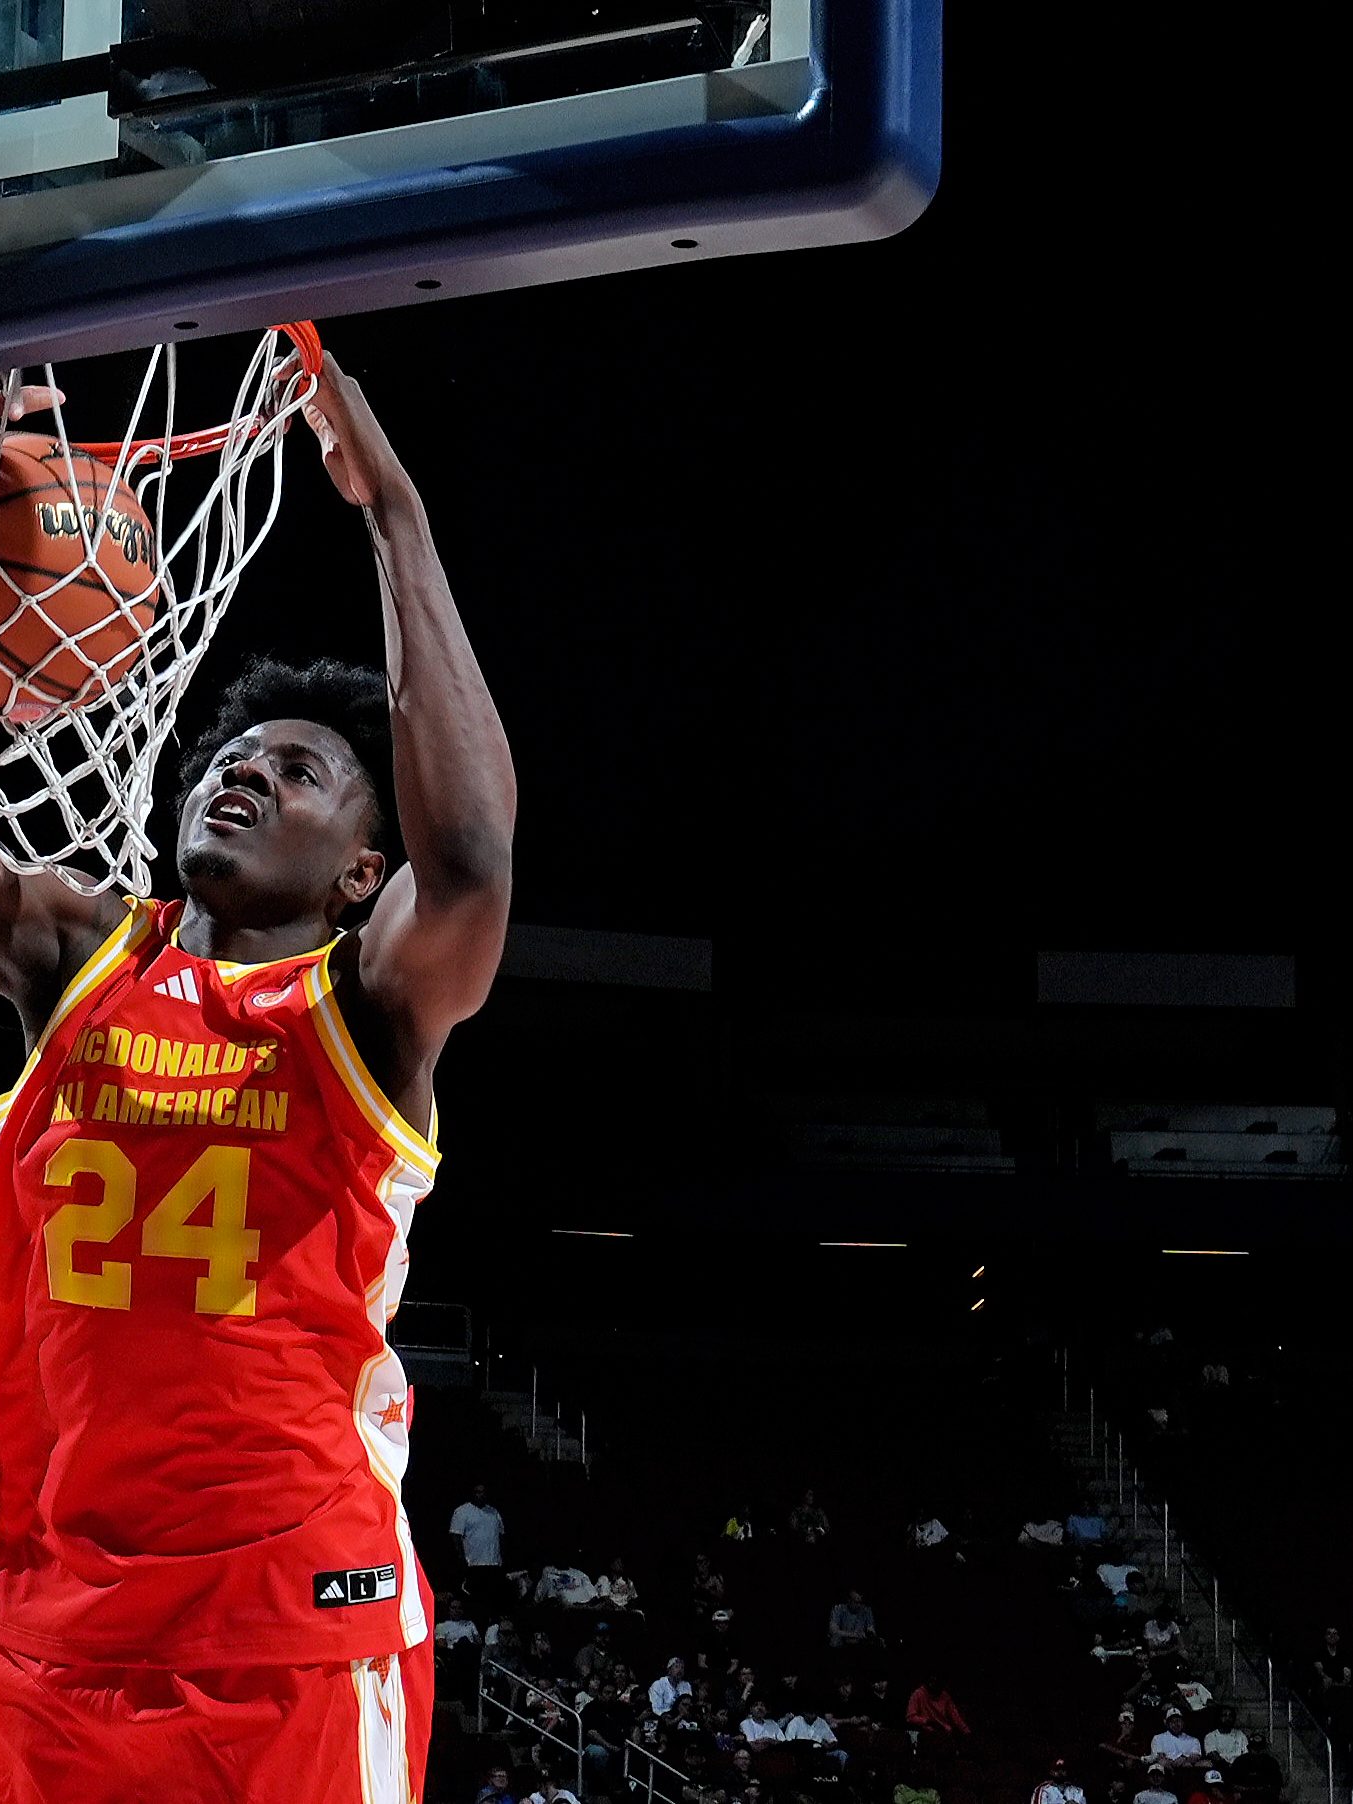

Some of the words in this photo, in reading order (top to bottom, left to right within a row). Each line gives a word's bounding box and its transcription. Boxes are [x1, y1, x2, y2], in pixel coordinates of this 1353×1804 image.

[92, 1085, 289, 1132] AMERICAN
[43, 1139, 261, 1317] 24
[360, 1582, 367, 1596] L
